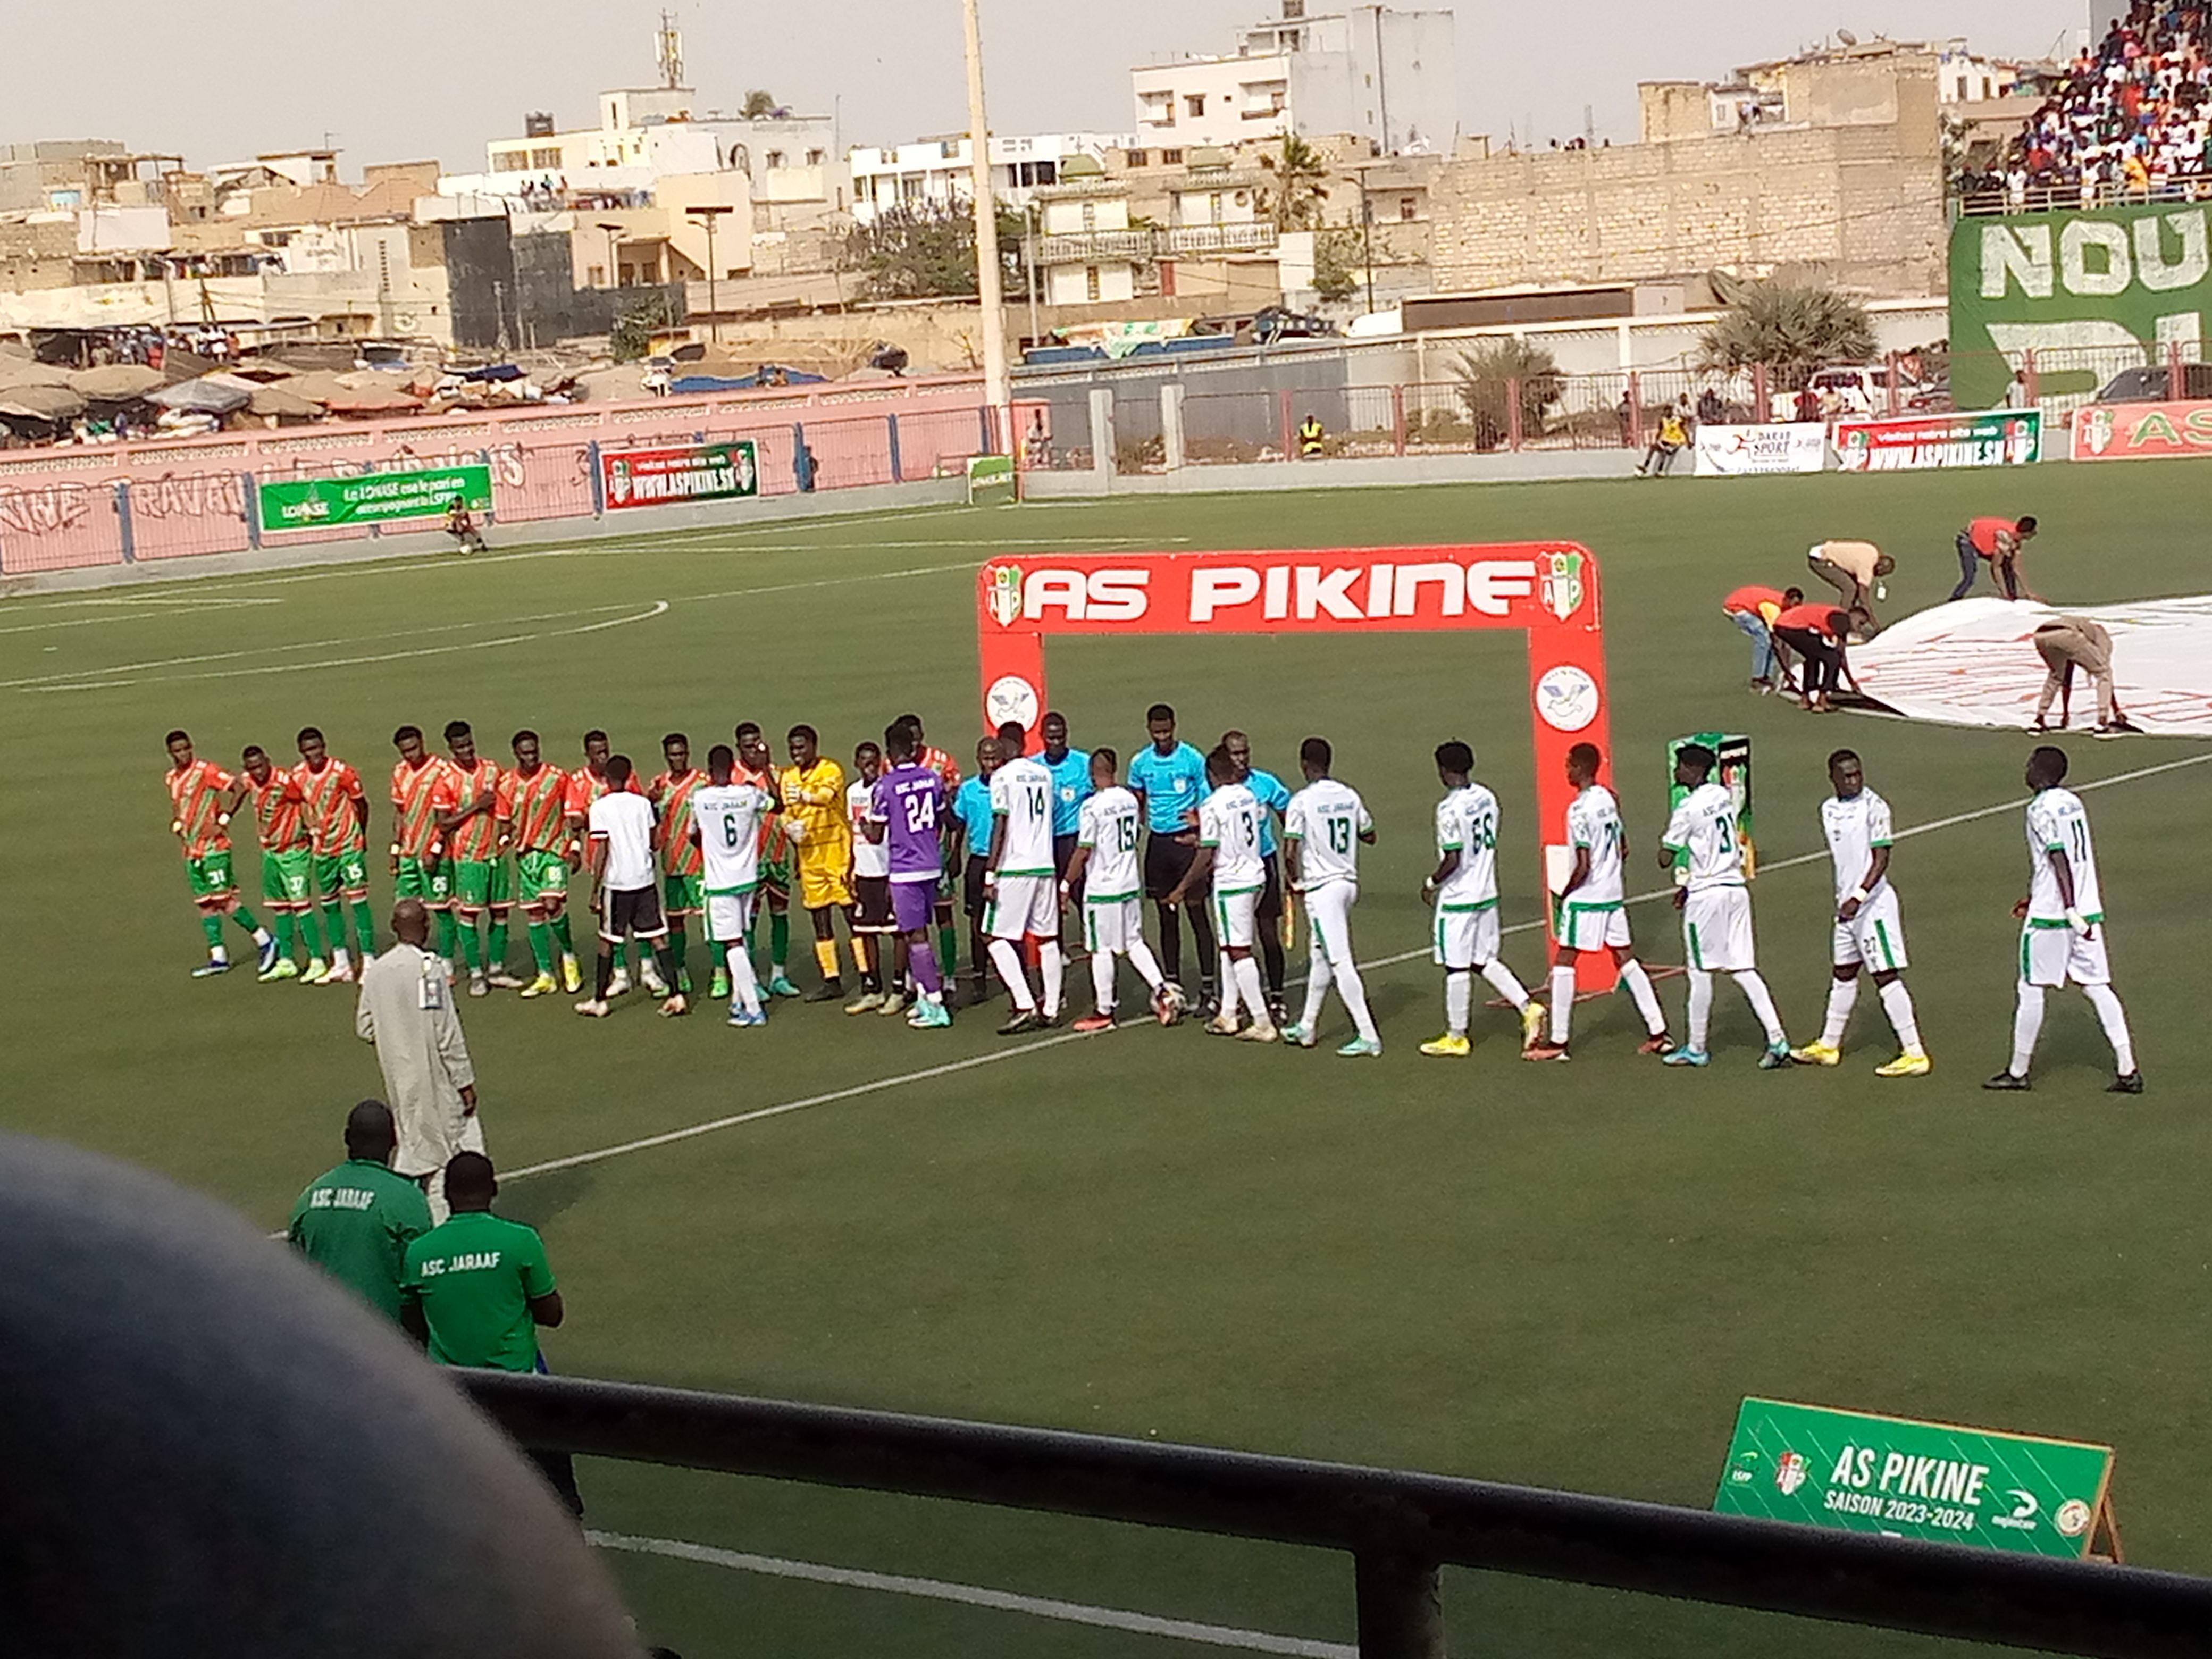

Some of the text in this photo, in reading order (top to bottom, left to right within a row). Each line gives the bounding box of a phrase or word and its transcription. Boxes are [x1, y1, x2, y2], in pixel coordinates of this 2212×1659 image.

[1980, 208, 2210, 298] NOU
[1023, 560, 1536, 623] AS PIKINE
[905, 791, 935, 833] 24
[1026, 785, 1045, 825] 14
[723, 814, 738, 847] 6
[1241, 811, 1255, 848] 3
[1327, 817, 1350, 854] 13
[2070, 819, 2087, 864] 11
[309, 1188, 333, 1208] ASC
[421, 1251, 501, 1277] ASC JARAAF
[1830, 1445, 1990, 1506] AS PIKINE
[1823, 1489, 1884, 1517] SAISON
[1884, 1499, 1975, 1531] 2023-2024
